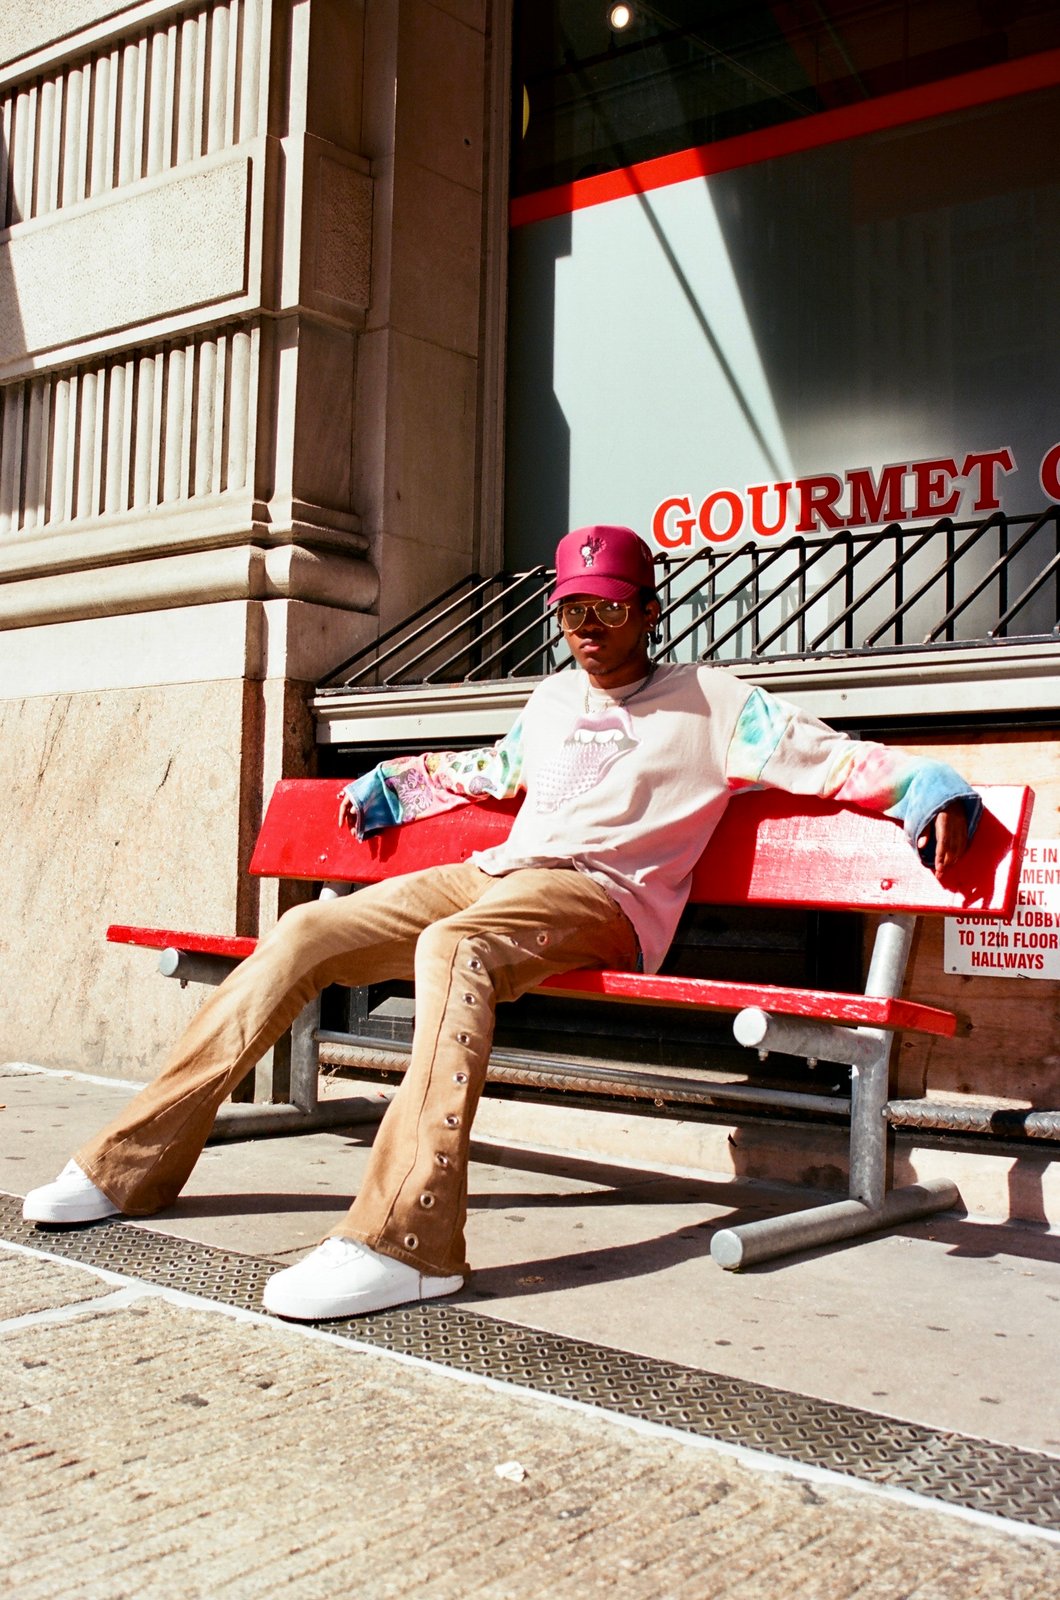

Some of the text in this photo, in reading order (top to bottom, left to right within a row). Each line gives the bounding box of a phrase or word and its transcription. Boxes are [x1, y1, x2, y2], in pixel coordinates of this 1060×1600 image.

[651, 448, 1015, 549] GOURMET
[1043, 848, 1057, 862] IN
[1019, 869, 1060, 884] MENT
[1017, 911, 1060, 928] LOBBY
[958, 930, 1058, 949] TO 12th FLOOR
[971, 951, 1044, 970] HALLWAYS
